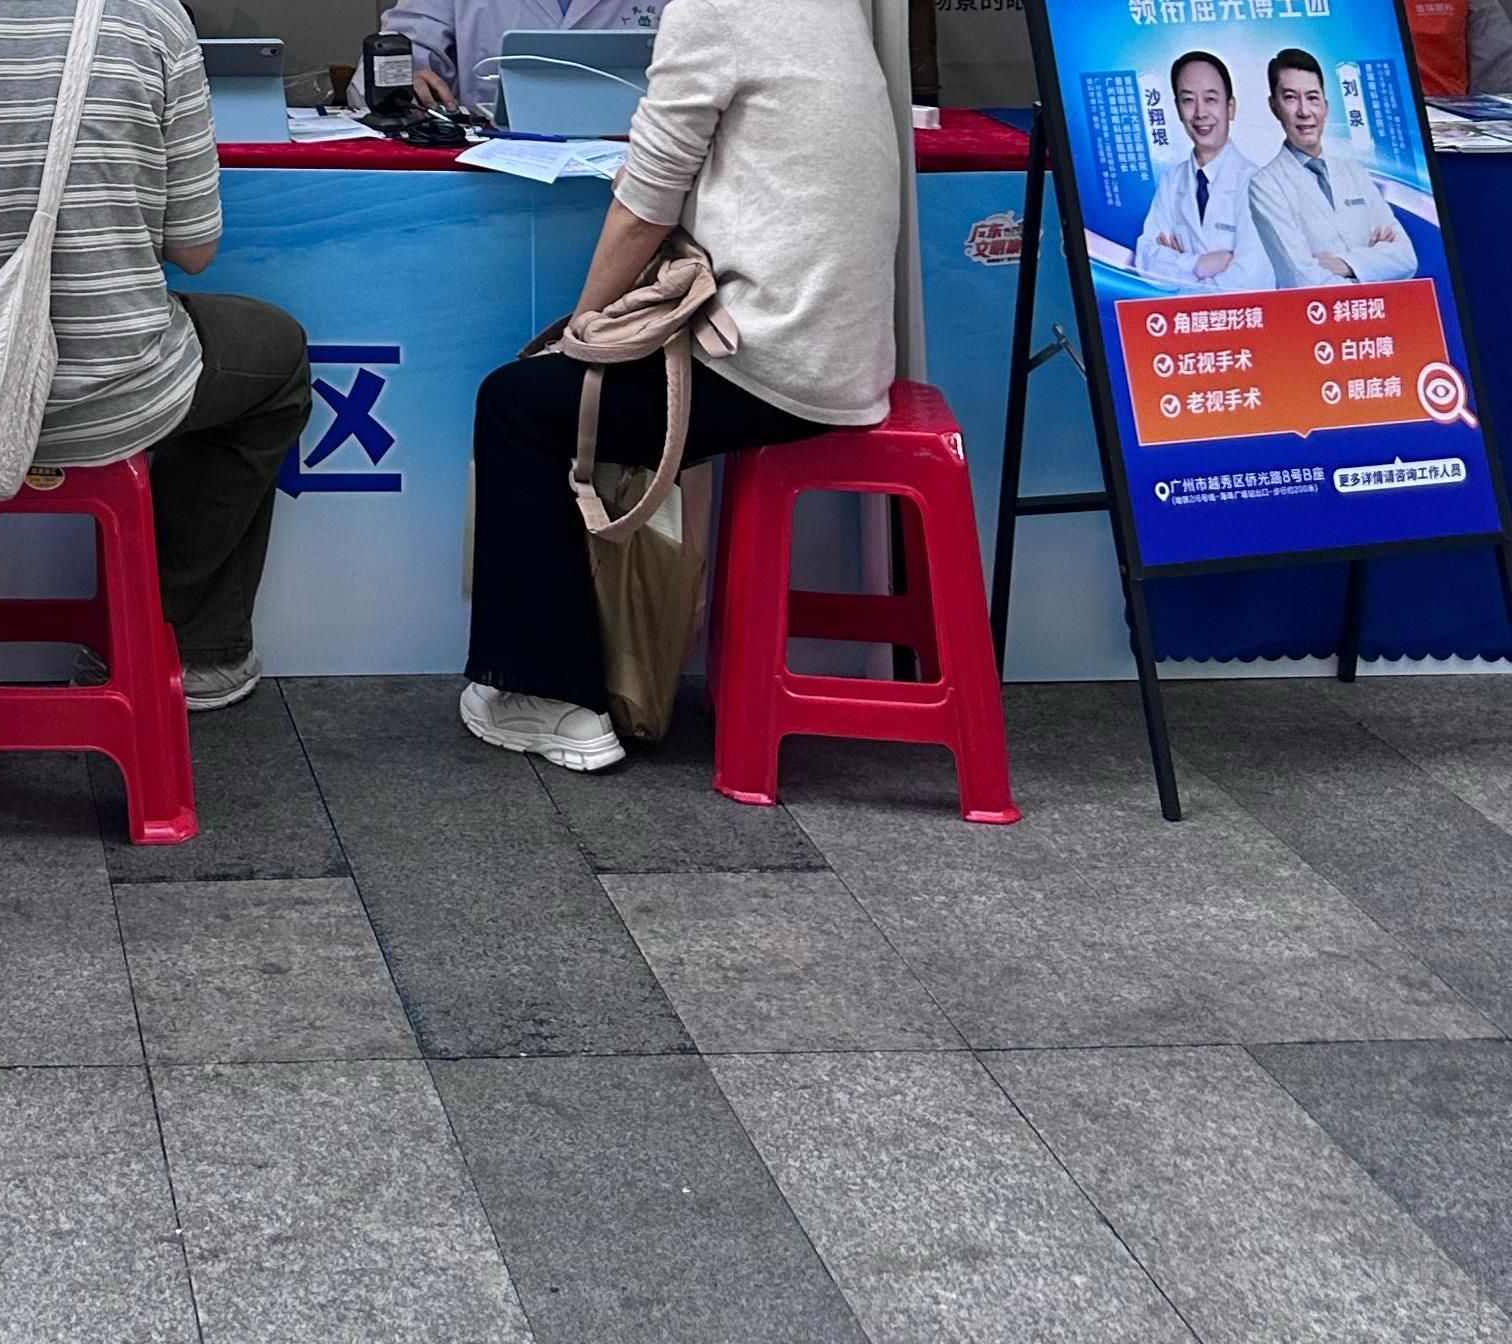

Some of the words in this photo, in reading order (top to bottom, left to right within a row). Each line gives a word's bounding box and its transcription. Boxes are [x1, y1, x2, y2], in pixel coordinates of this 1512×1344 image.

[1173, 307, 1264, 334] 角膜塑形镜
[1333, 297, 1386, 321] 斜弱视
[1341, 336, 1394, 361] 白内障
[1178, 349, 1253, 375] 近视手术
[1186, 387, 1262, 413] 老视手术
[1348, 377, 1402, 400] 眼底病
[277, 345, 402, 499] 区
[1339, 464, 1462, 488] 更多详情请咨询工作人员
